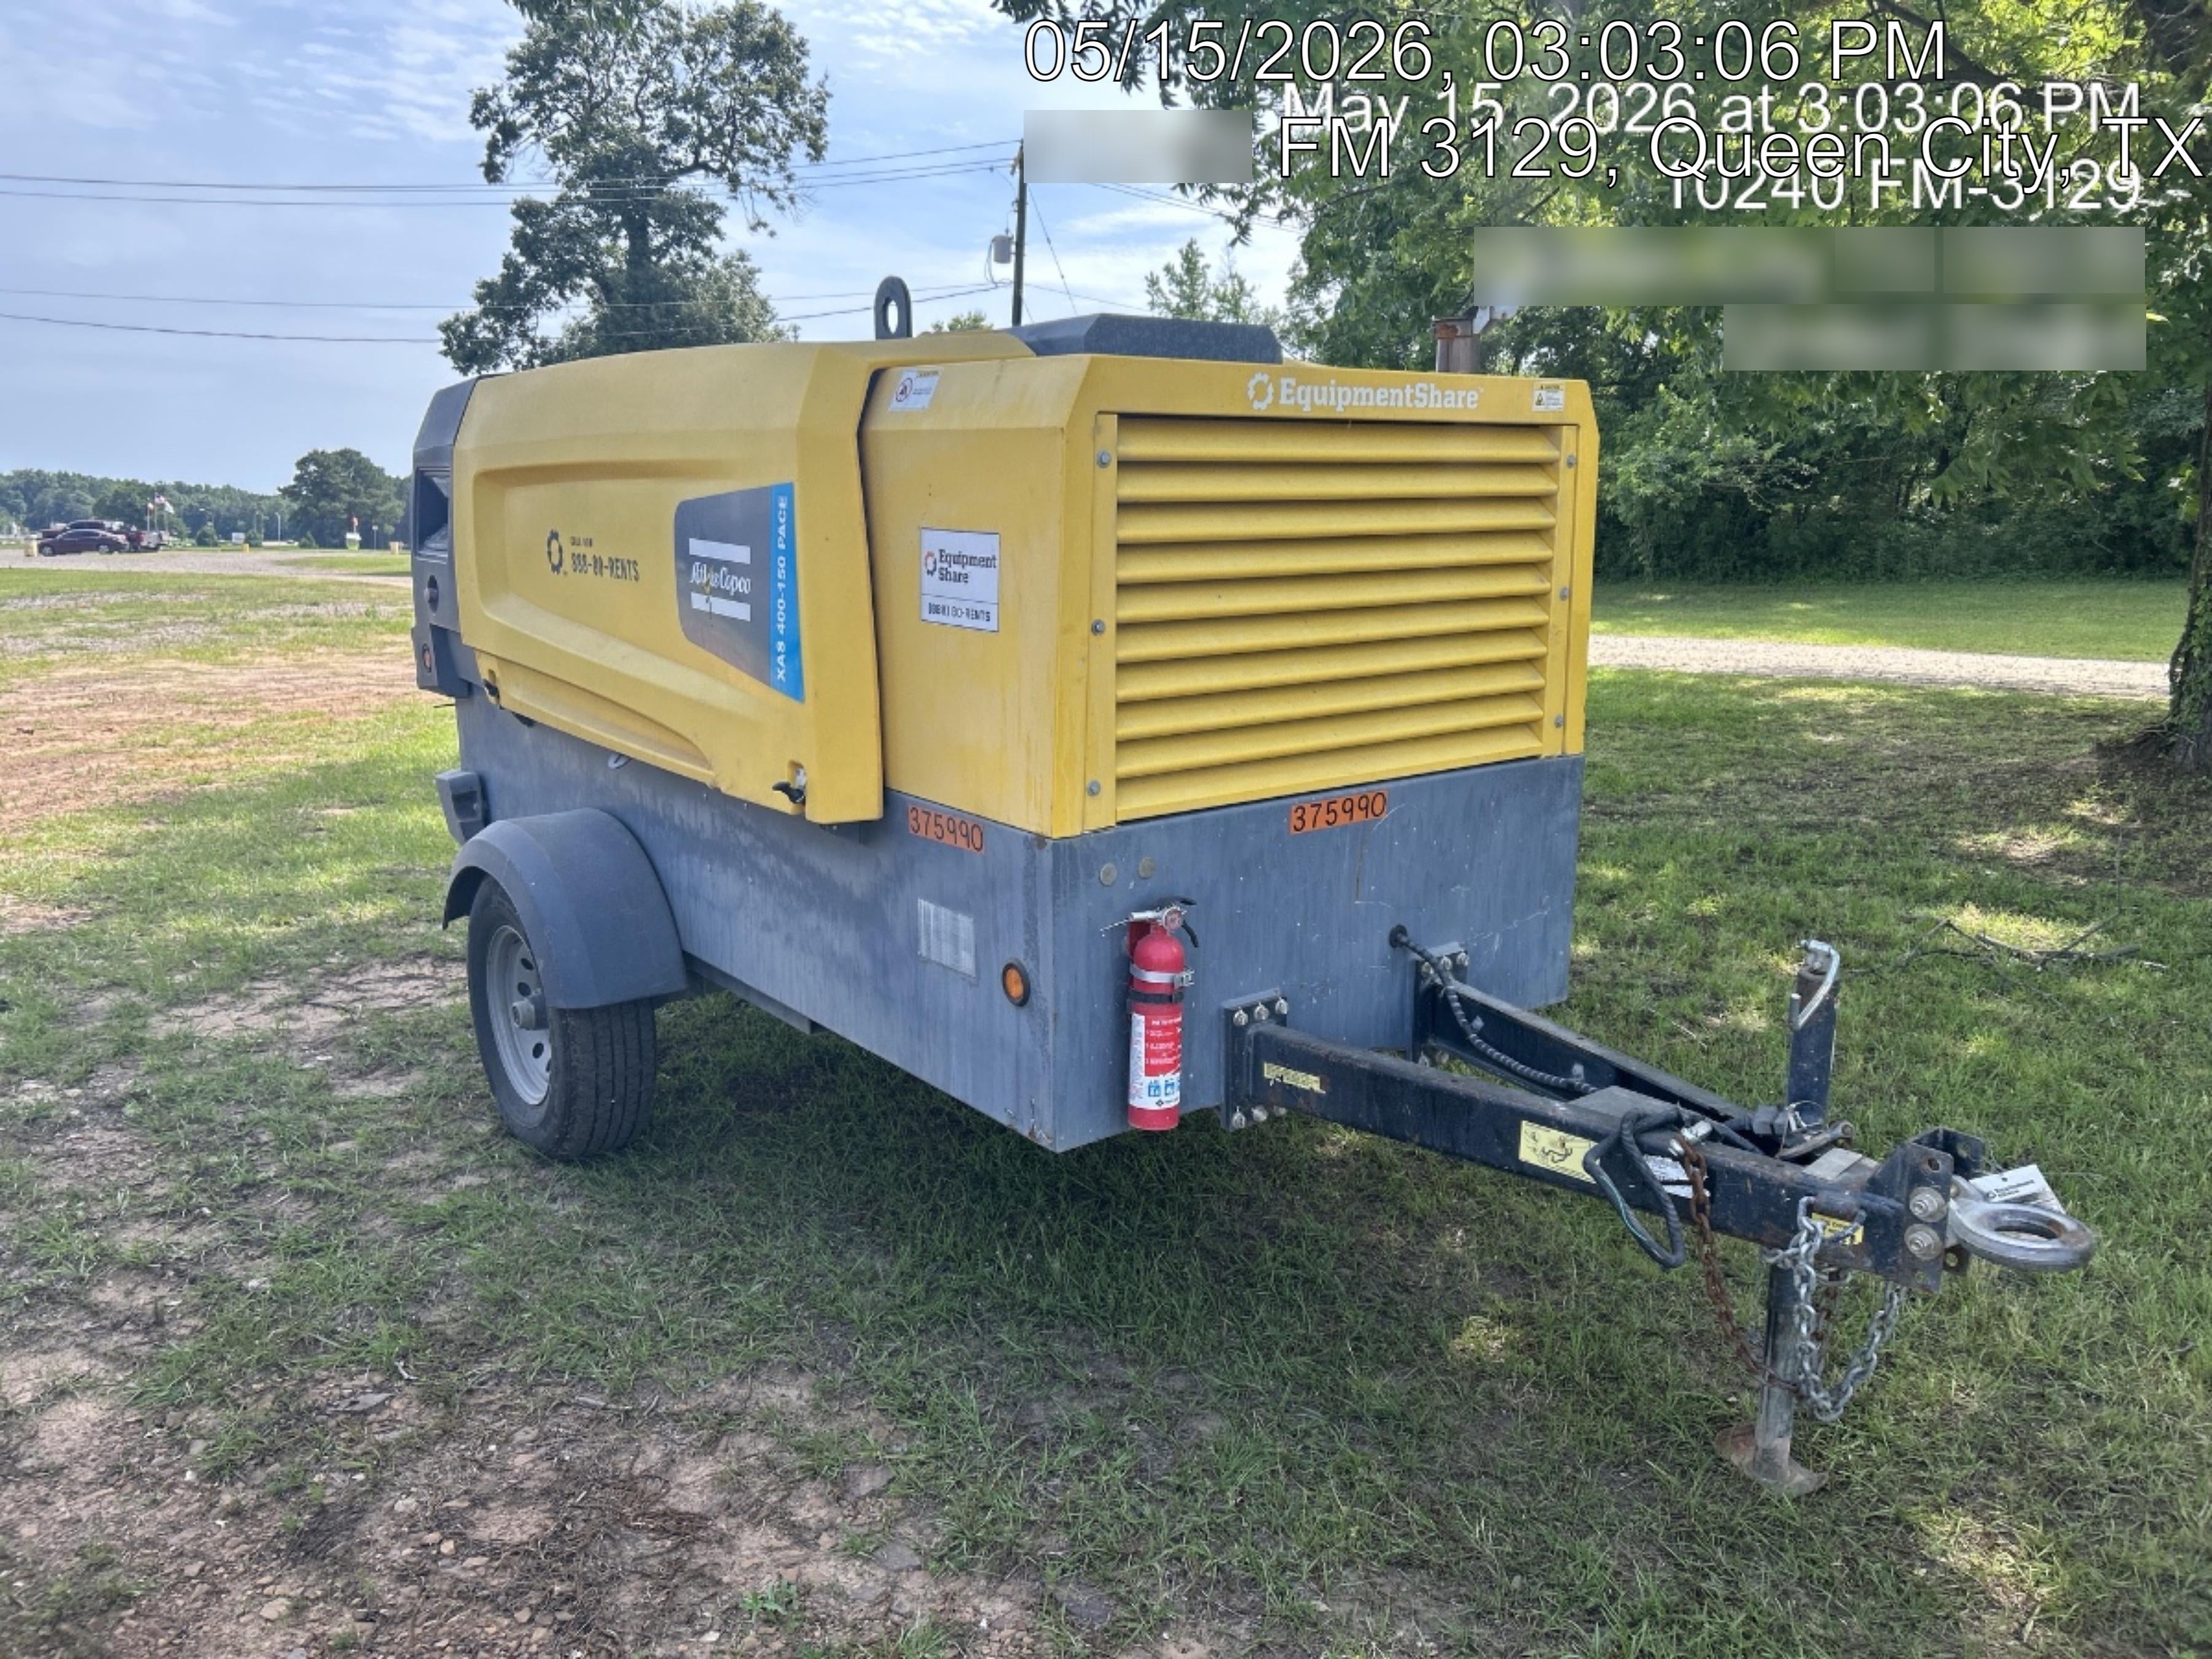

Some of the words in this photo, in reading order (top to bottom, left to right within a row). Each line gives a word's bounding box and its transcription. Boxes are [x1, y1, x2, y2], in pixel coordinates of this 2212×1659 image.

[1279, 377, 1480, 412] EquipmentShare
[777, 495, 788, 550] PACE
[938, 549, 998, 569] Equipment
[938, 567, 969, 584] Share
[775, 556, 786, 635] 400-150
[775, 641, 786, 683] XAS
[909, 806, 983, 852] 375990
[1293, 791, 1387, 832] 375990
